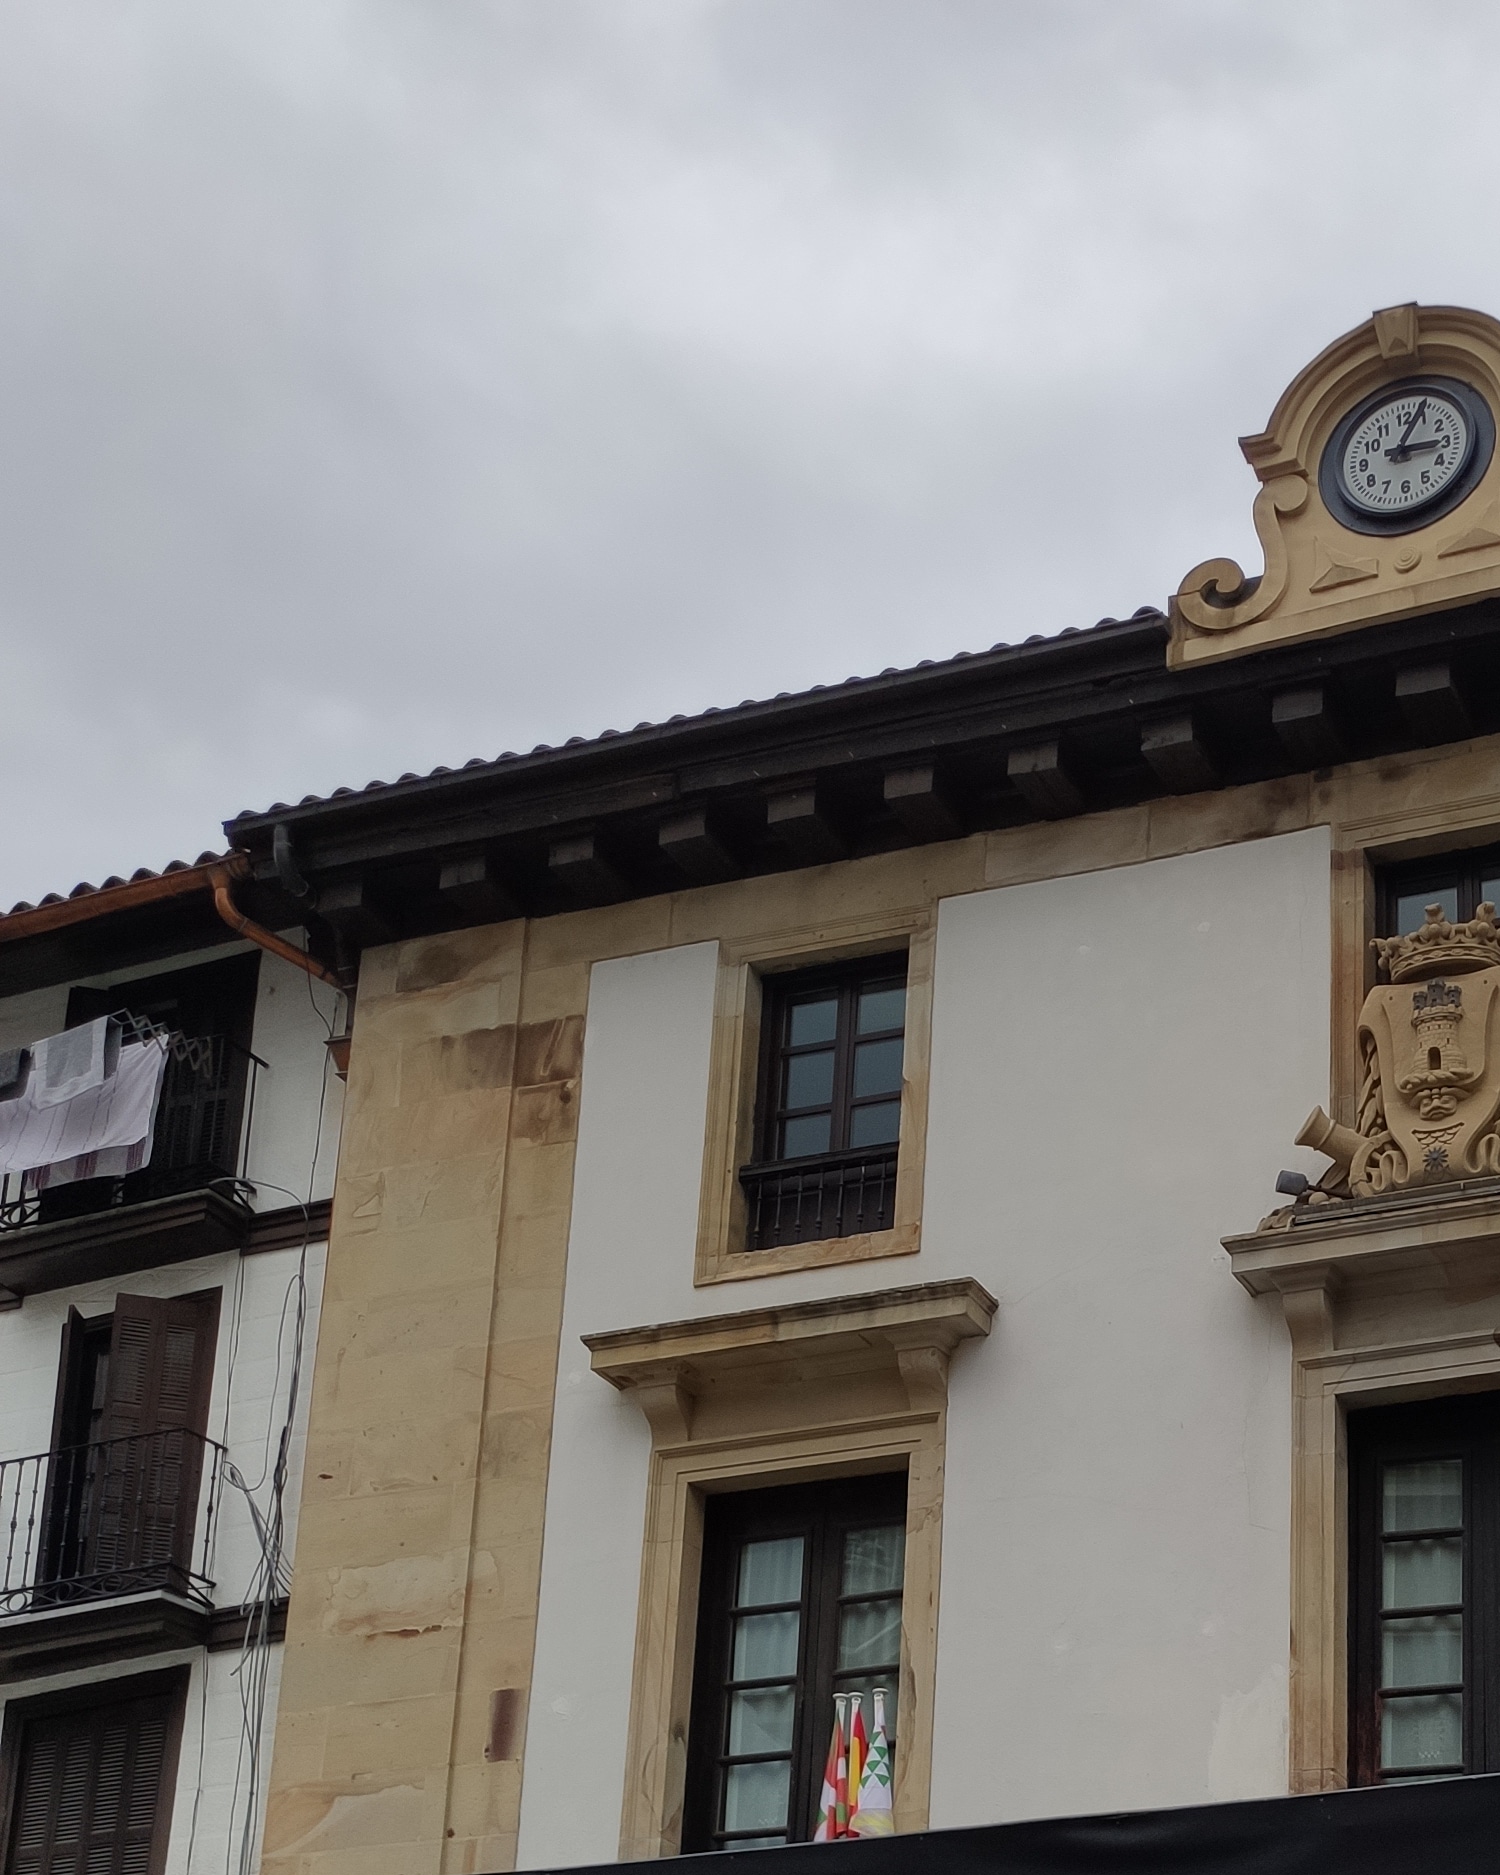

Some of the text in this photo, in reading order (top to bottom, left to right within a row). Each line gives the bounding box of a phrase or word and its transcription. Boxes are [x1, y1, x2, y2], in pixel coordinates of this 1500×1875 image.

[1396, 411, 1412, 426] 12
[1377, 423, 1389, 438] 11
[1434, 419, 1444, 433] 2
[1364, 439, 1380, 454] 10
[1440, 435, 1450, 448] 3
[1359, 459, 1368, 472] 9
[1434, 453, 1445, 467] 4
[1366, 474, 1376, 488] 8
[1421, 470, 1430, 484] 5
[1382, 480, 1392, 494] 7
[1401, 480, 1411, 494] 6
